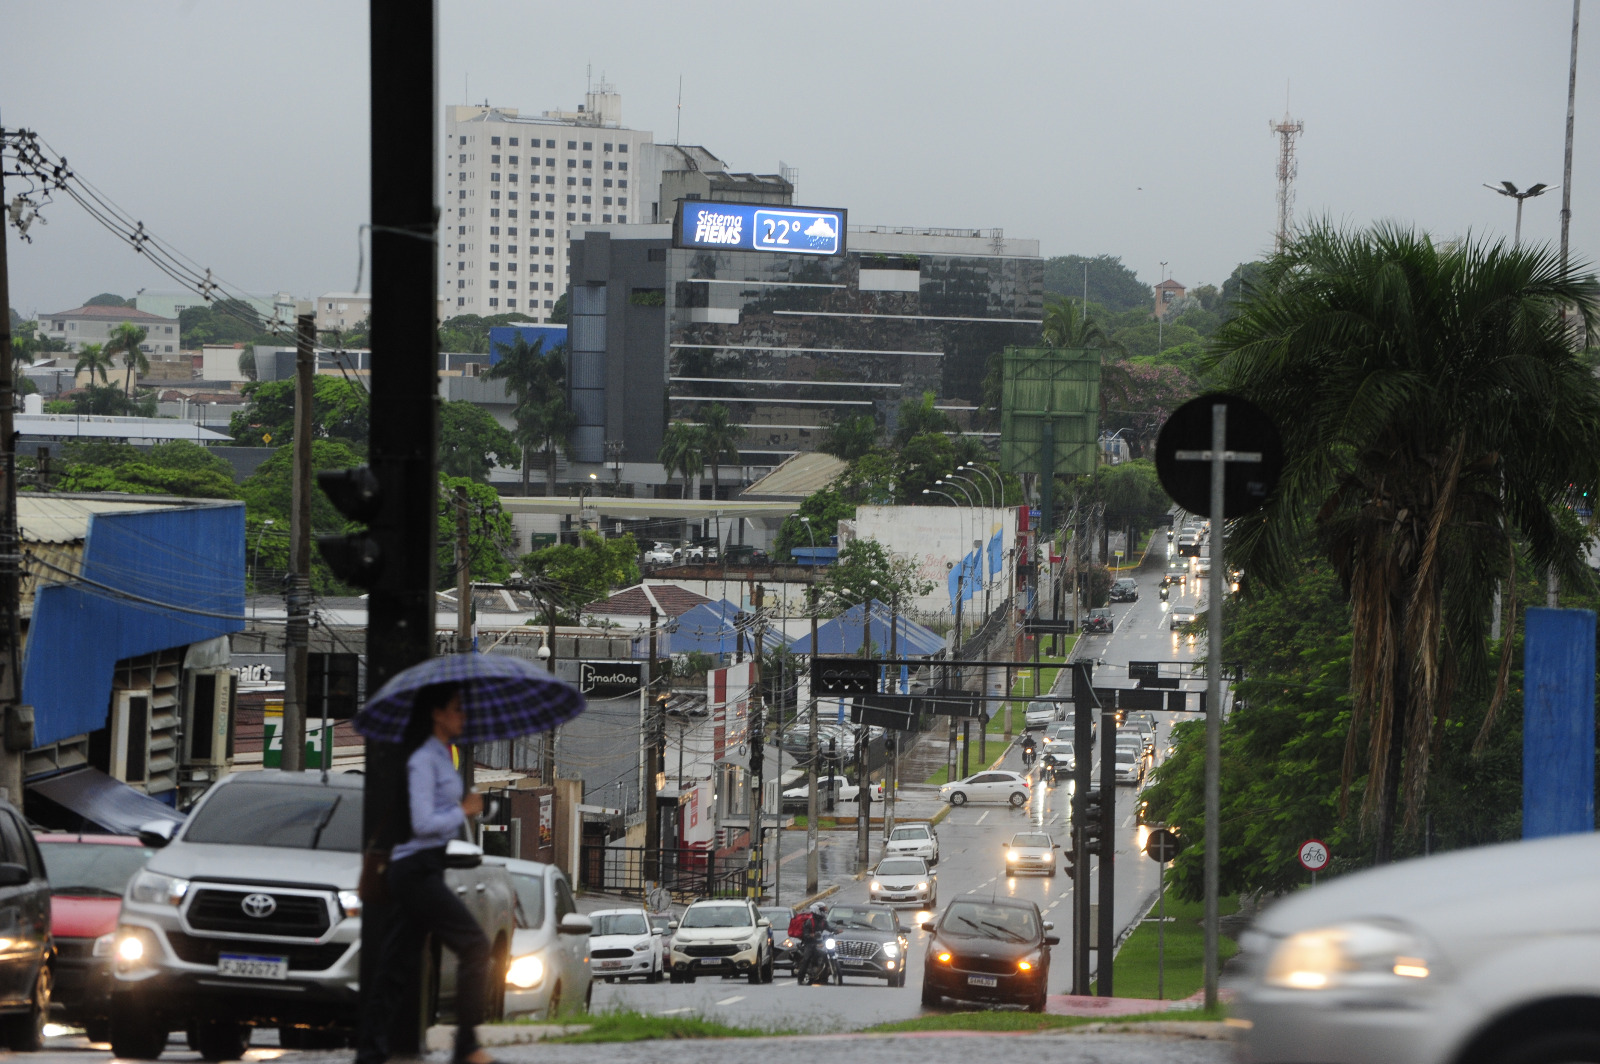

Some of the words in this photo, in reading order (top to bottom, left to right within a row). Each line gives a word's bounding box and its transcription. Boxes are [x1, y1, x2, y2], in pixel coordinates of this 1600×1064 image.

[696, 210, 743, 228] Sistema
[694, 225, 743, 245] FIEMS
[762, 218, 801, 245] 22°
[587, 672, 638, 684] SmartOne
